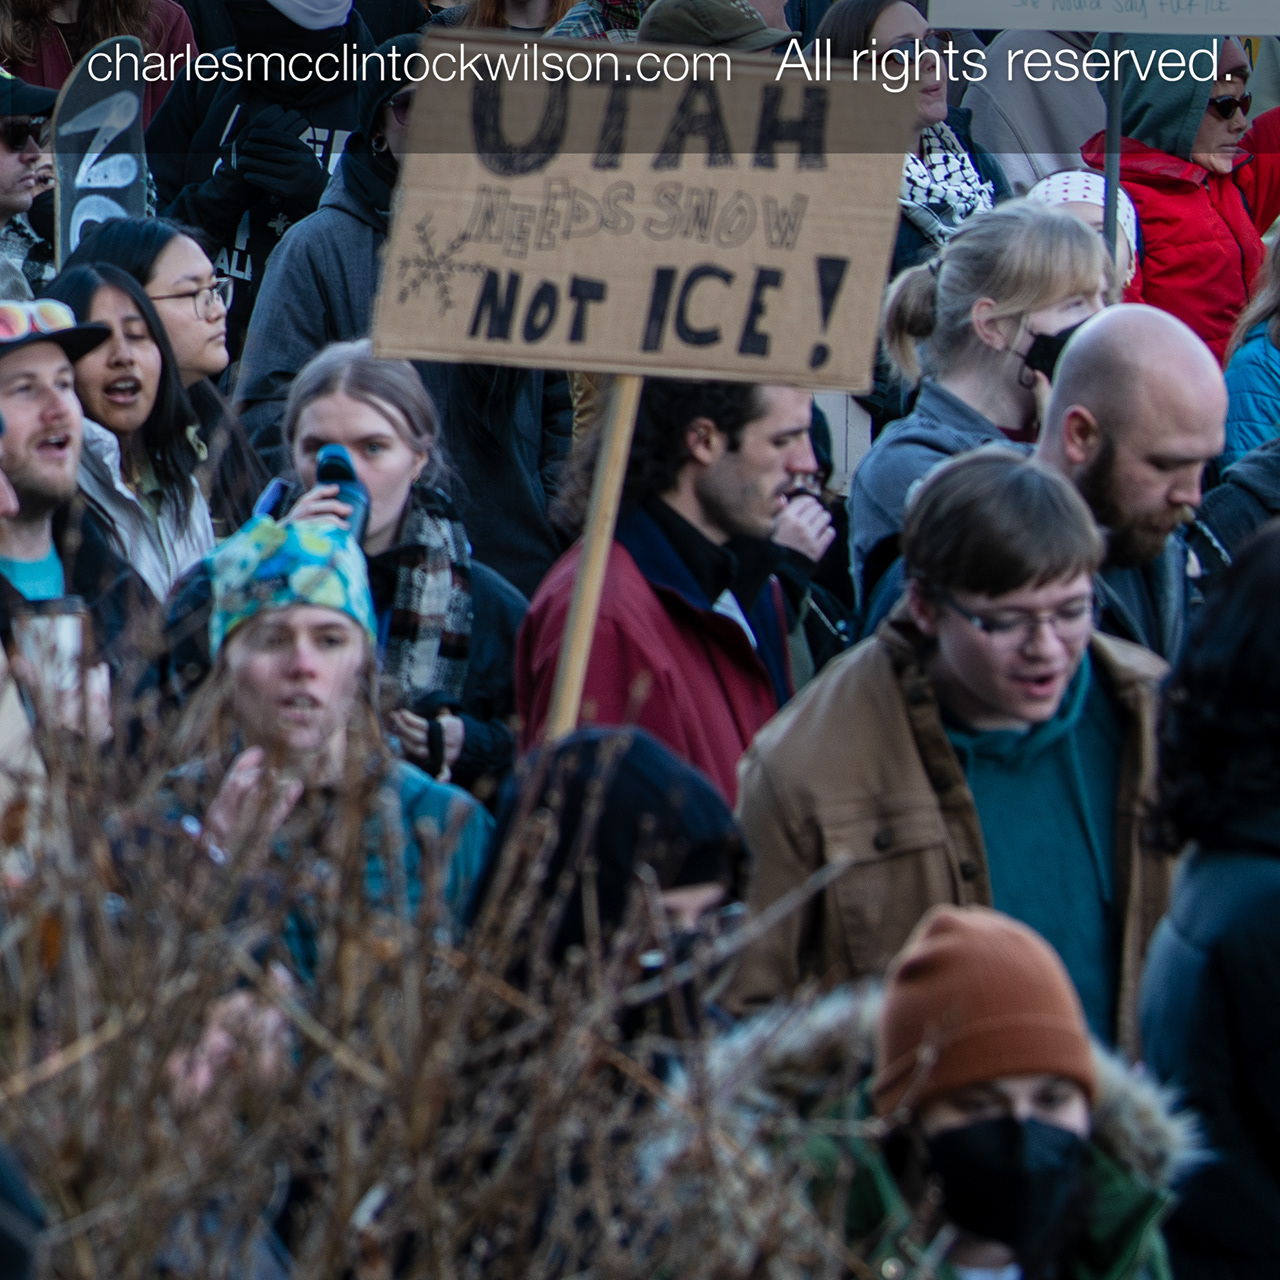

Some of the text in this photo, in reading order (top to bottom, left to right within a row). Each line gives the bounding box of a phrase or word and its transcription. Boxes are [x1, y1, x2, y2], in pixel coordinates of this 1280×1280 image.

[471, 63, 828, 176] UTAH
[645, 182, 809, 250] SNOW
[468, 268, 607, 344] NOT
